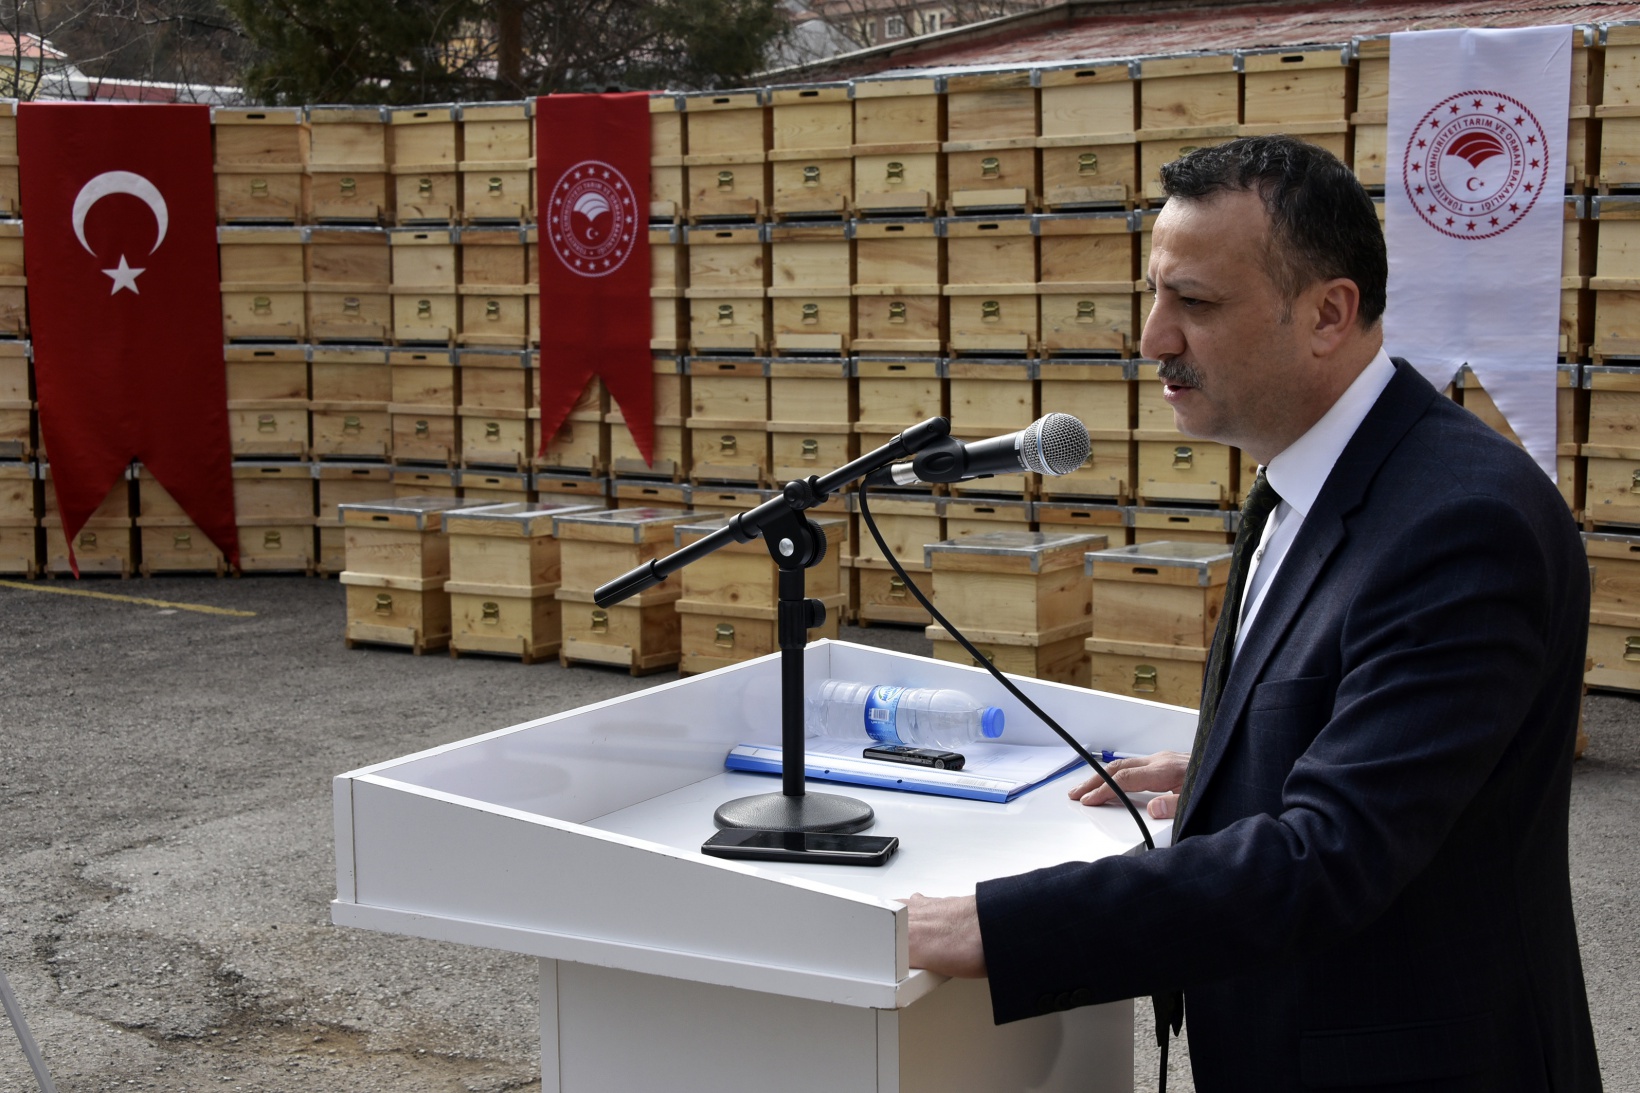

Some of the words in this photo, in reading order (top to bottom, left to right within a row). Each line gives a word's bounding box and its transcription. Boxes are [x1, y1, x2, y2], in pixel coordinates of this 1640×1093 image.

[1463, 117, 1493, 127] TARIM
[1495, 122, 1507, 134] VE
[1429, 121, 1461, 182] CUMHURİYETİ
[1505, 132, 1521, 167] ORMAN
[1432, 182, 1463, 212] TÜRKİYE
[1481, 169, 1520, 212] BAKANLIĞI
